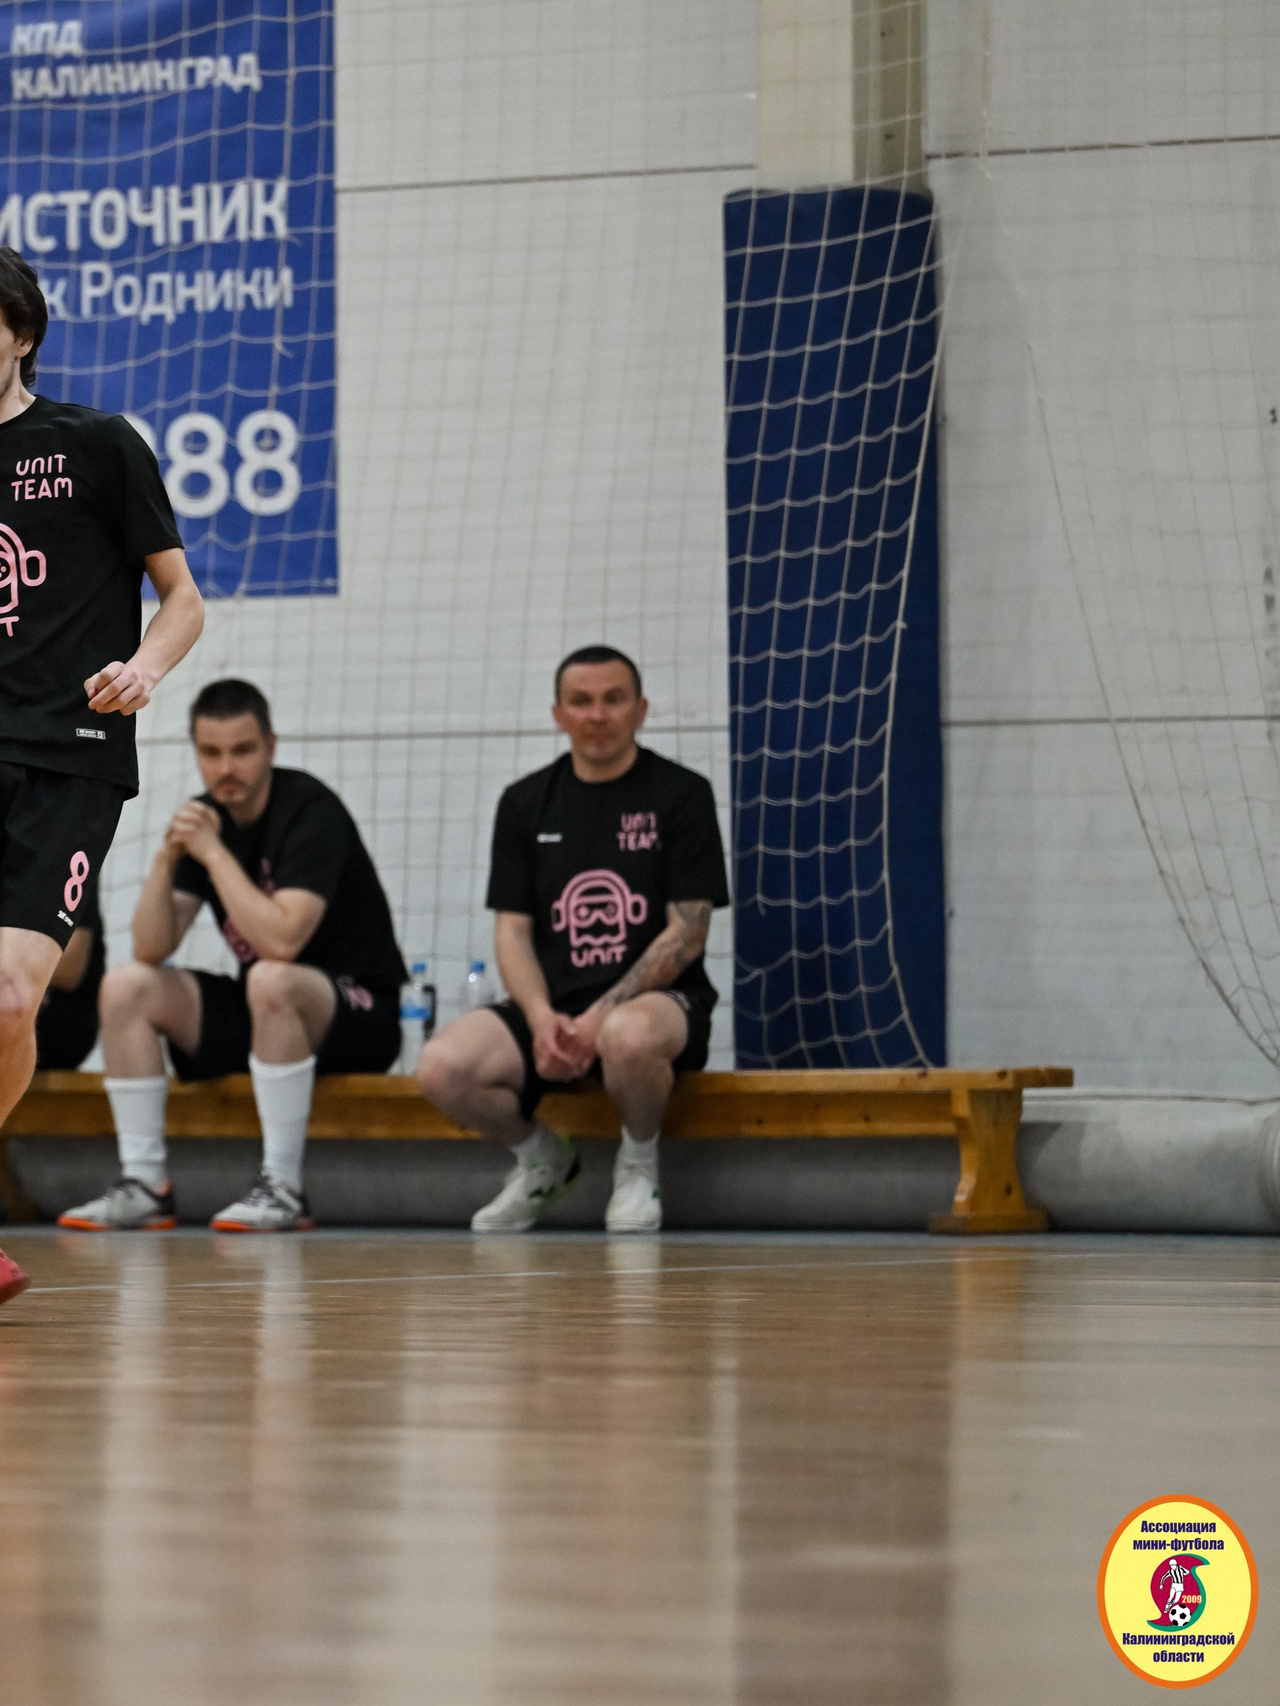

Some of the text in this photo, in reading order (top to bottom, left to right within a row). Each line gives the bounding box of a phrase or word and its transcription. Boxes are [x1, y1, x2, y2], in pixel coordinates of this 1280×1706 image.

[11, 20, 83, 58] КПД
[11, 53, 262, 100] КАЛИНИНГРАД
[81, 261, 294, 325] Родники
[16, 454, 67, 477] UNIT
[11, 477, 73, 501] TEAM
[64, 850, 90, 912] 8
